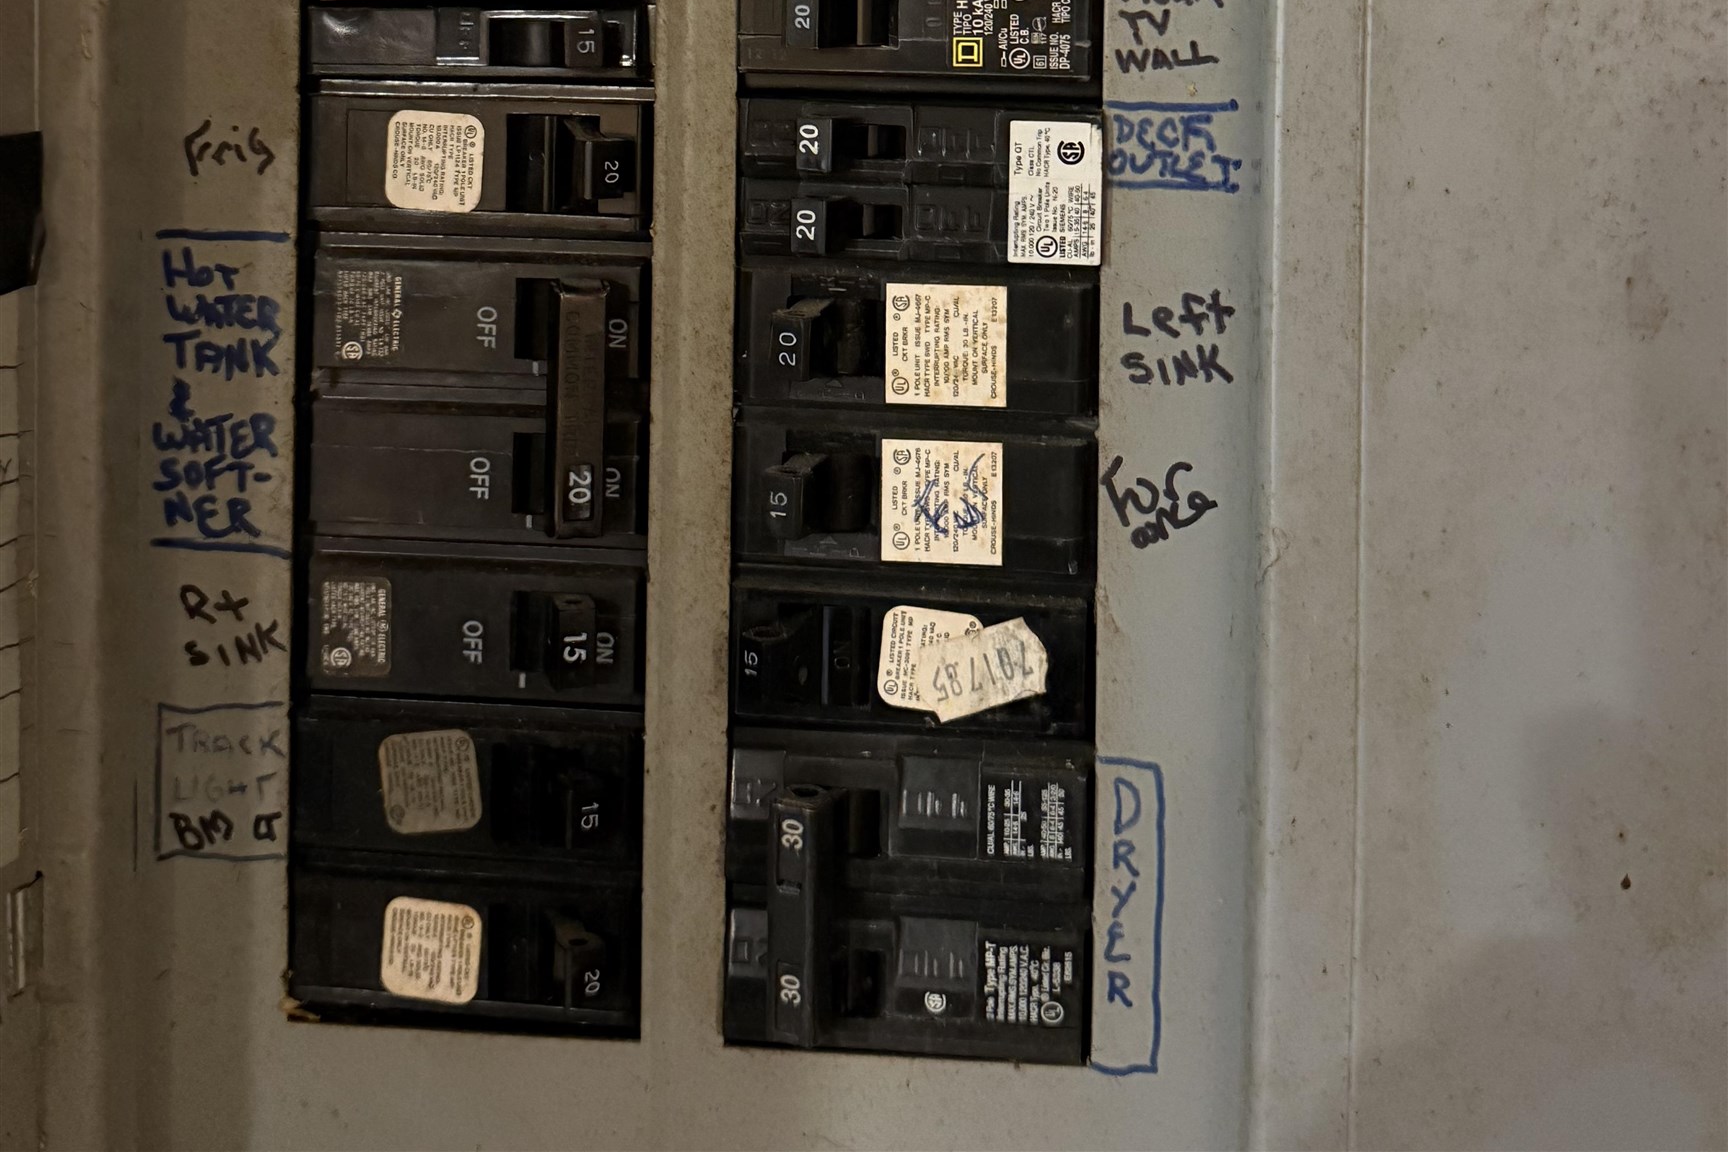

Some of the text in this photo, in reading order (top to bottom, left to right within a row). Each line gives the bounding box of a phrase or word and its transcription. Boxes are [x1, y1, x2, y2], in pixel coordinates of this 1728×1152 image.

[795, 4, 811, 29] 20
[953, 11, 963, 36] TYPE
[963, 13, 972, 36] TIPO
[972, 19, 984, 36] 10
[984, 3, 993, 36] 120/240
[1052, 1, 1061, 24] HACR
[1061, 6, 1070, 24] TIPO
[1118, 9, 1170, 45] TV
[577, 28, 595, 55] 15
[1010, 13, 1019, 45] LISTED
[1020, 27, 1029, 45] C.B.
[1050, 31, 1059, 70] ISSUE NO.
[1060, 34, 1071, 70] DP-4075
[1115, 40, 1220, 73] WALL
[800, 124, 819, 156] 20
[1113, 114, 1216, 152] DECK
[604, 160, 619, 185] 20
[1014, 142, 1023, 175] Type QT
[796, 210, 816, 241] 20
[166, 295, 282, 336] WATER
[476, 306, 498, 349] OFF
[1123, 289, 1235, 337] Left
[609, 318, 628, 348] ON
[779, 332, 797, 366] 20
[163, 330, 281, 381] TANK
[1120, 344, 1234, 385] SINK
[152, 413, 278, 459] WATER
[469, 457, 490, 500] OFF
[568, 471, 592, 505] 20
[605, 467, 621, 498] ON
[164, 491, 261, 538] NER
[770, 491, 787, 518] 15
[378, 589, 386, 617] GENERAL
[891, 613, 899, 638] CIRCUIT
[184, 618, 287, 666] SINK
[462, 621, 483, 664] OFF
[563, 633, 587, 663] 15
[596, 632, 614, 664] ON
[744, 650, 759, 676] 15
[895, 650, 903, 680] BREAKER
[166, 722, 286, 757] TRACK
[580, 802, 598, 830] 15
[781, 819, 804, 851] 30
[1103, 777, 1142, 1009] DRYER
[585, 970, 600, 995] 20
[780, 974, 801, 1003] 30
